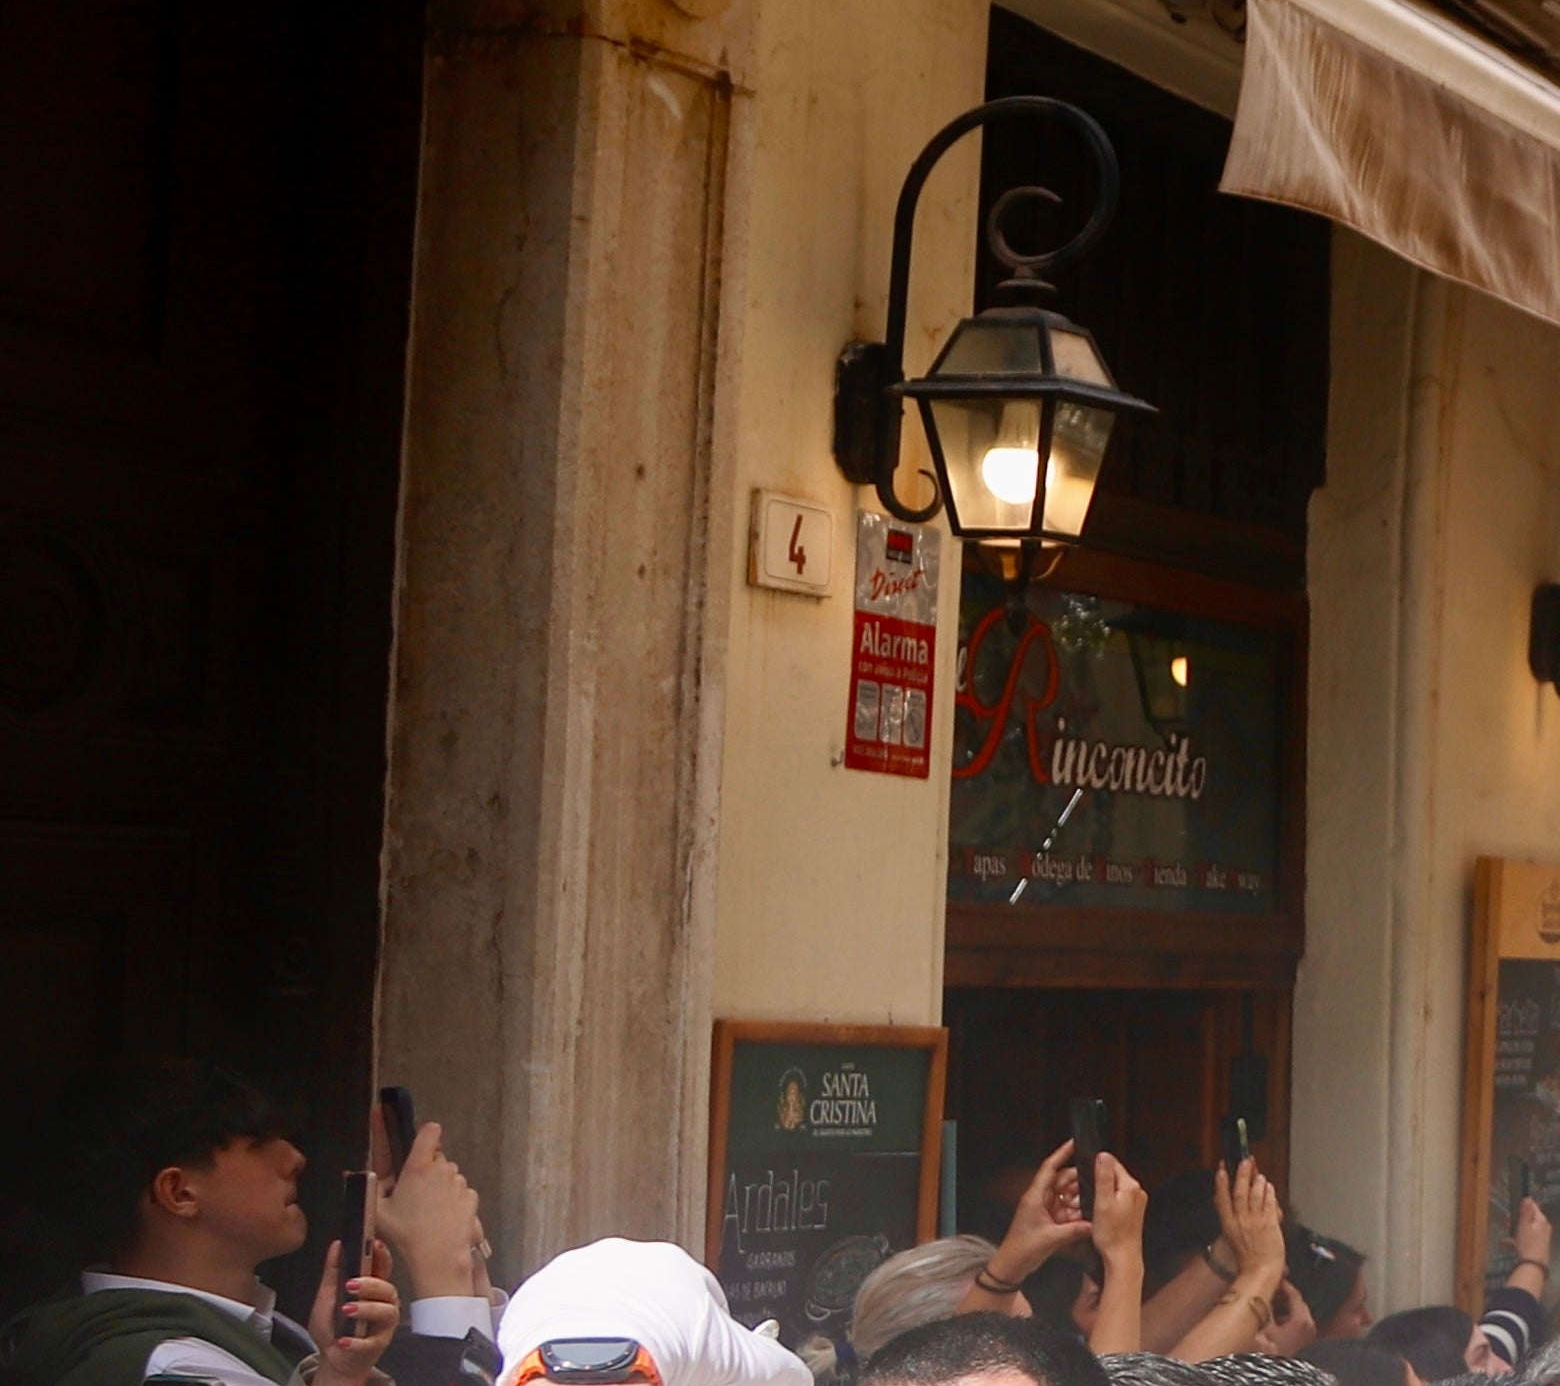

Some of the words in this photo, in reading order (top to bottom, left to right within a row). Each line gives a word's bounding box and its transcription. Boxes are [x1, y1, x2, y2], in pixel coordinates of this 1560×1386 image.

[789, 514, 807, 575] 4
[860, 621, 928, 665] Alarma
[1075, 856, 1093, 881] de
[821, 1072, 869, 1098] SANTA
[810, 1099, 877, 1125] CRISTINA
[725, 1169, 830, 1255] Ardales
